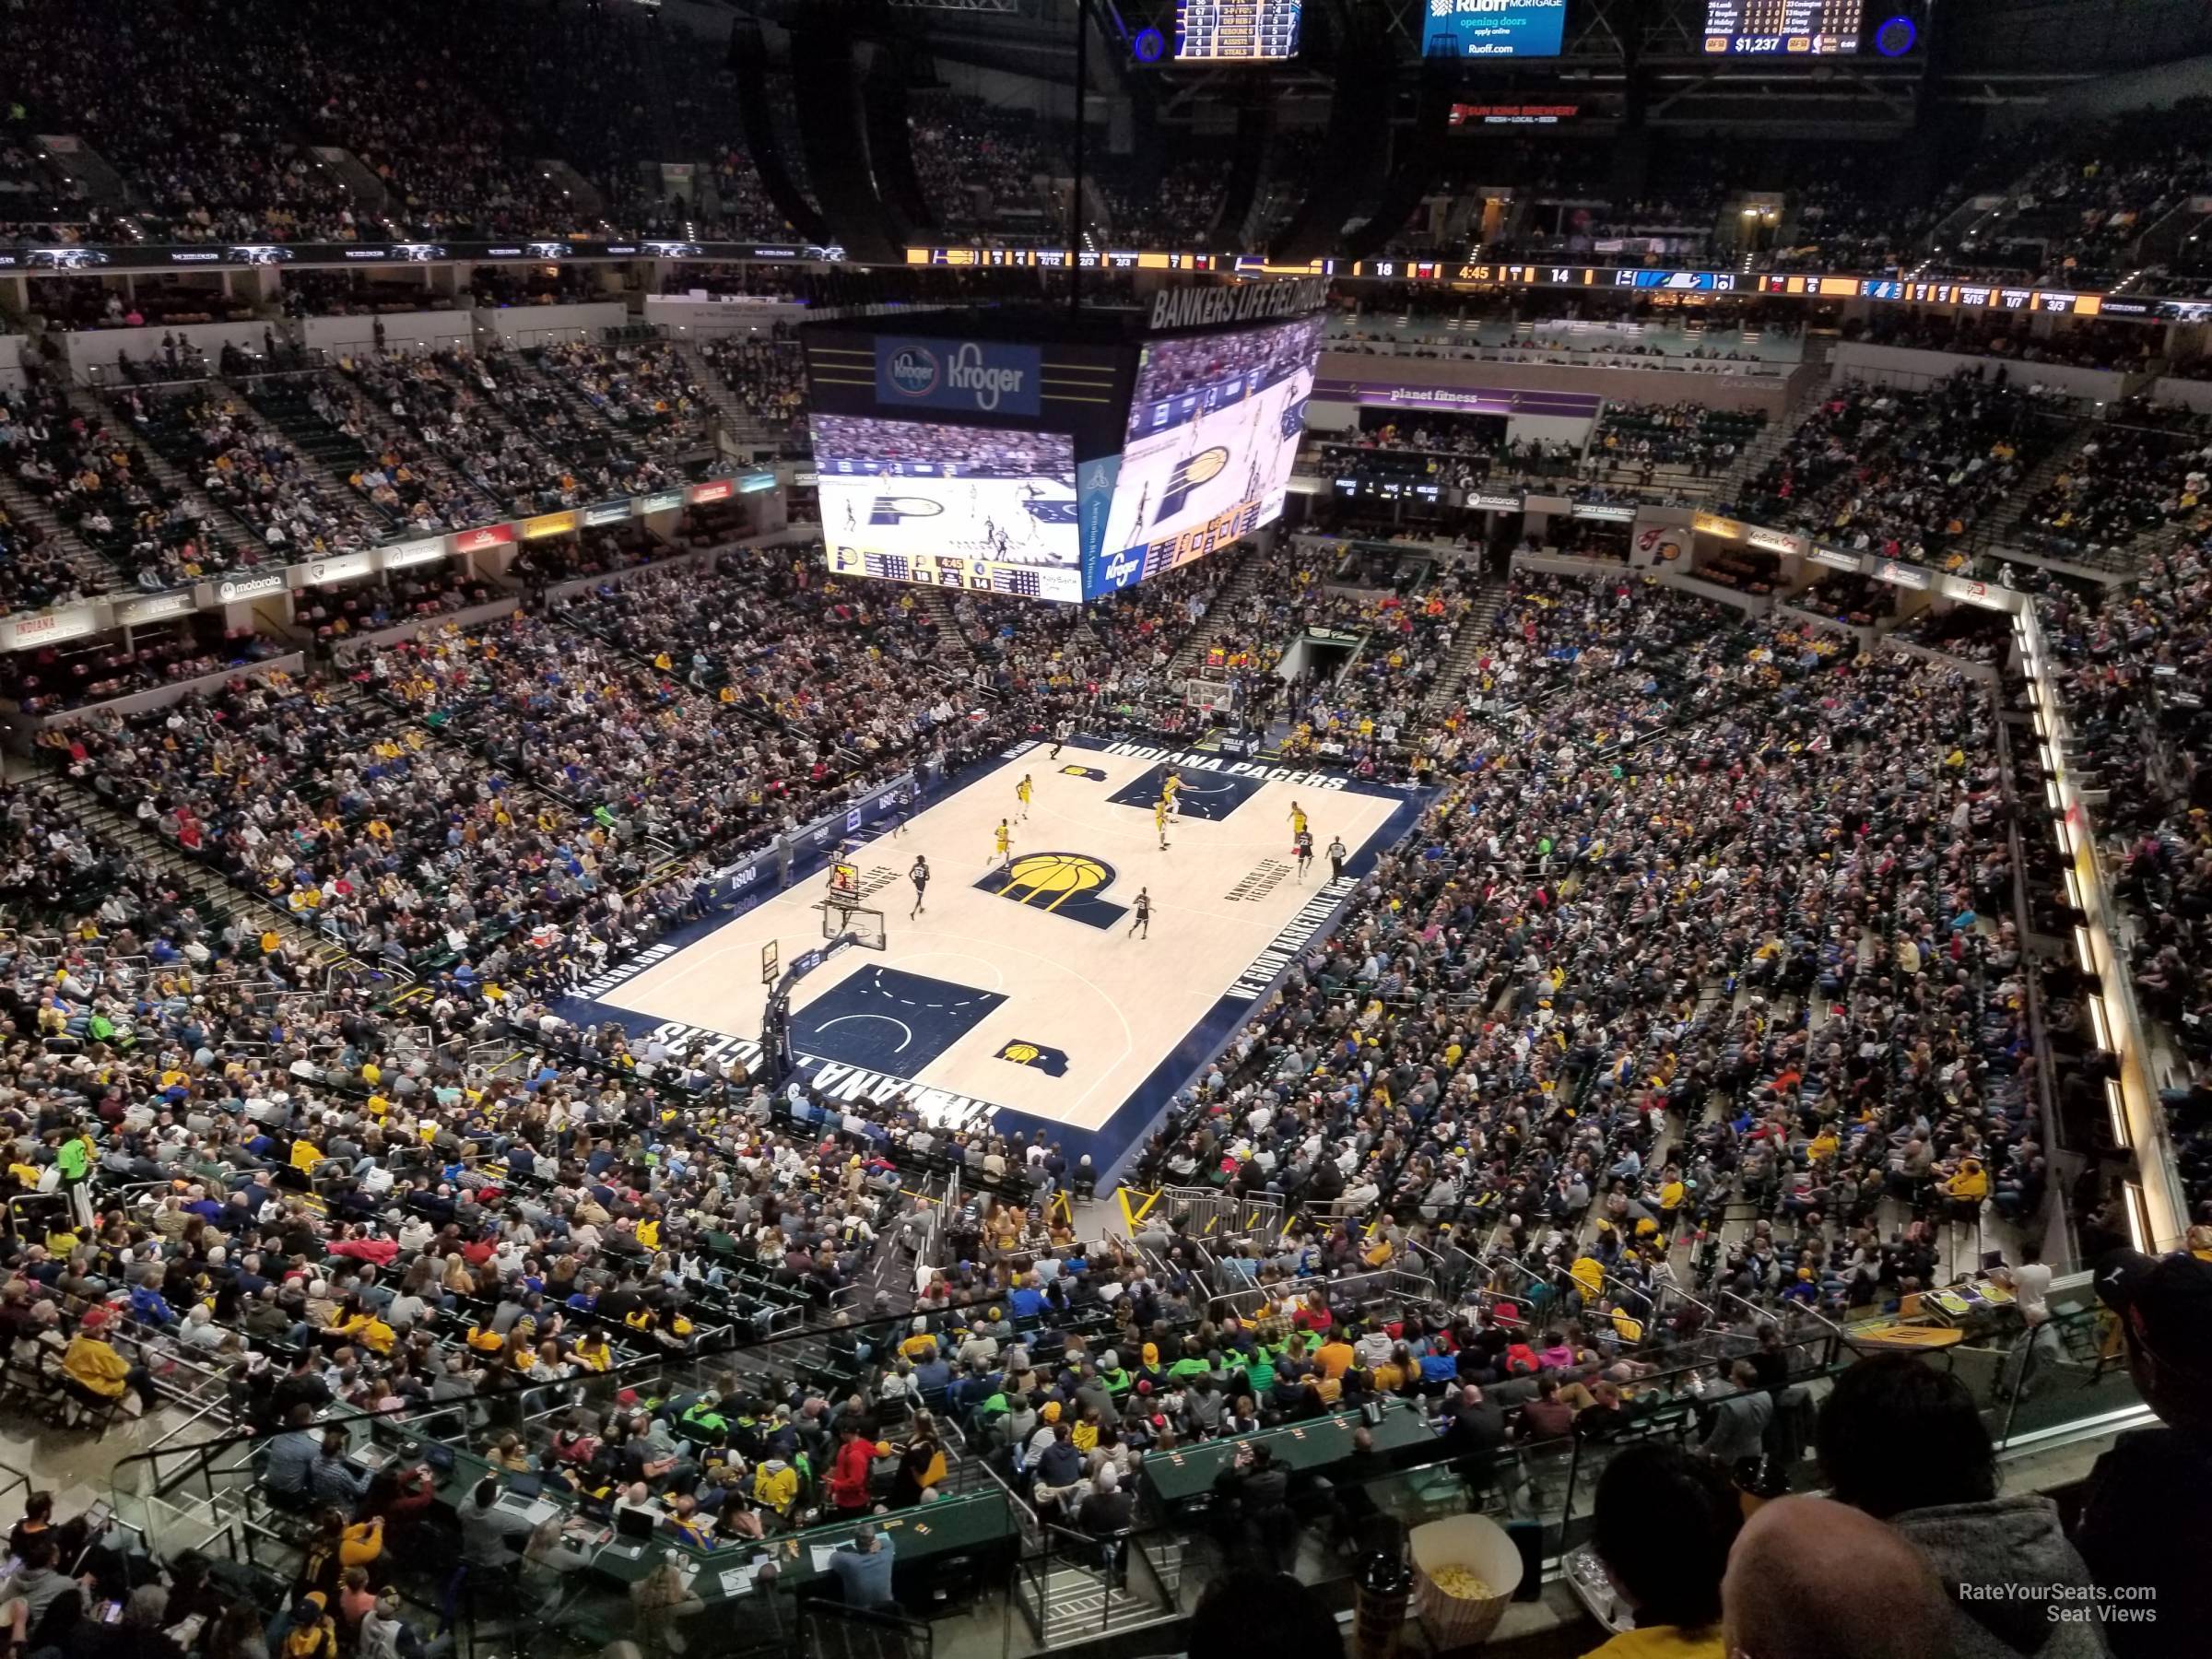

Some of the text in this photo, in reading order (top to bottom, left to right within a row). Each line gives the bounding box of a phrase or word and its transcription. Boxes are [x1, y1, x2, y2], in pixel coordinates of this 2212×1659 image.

[1461, 17, 1526, 28] opening doors
[1469, 43, 1513, 53] Ruoff.com
[1735, 39, 1779, 53] $1,237
[1171, 260, 1178, 268] 7
[1376, 264, 1393, 276] 18
[1459, 266, 1488, 279] 4:45
[1552, 269, 1569, 282] 14
[1772, 283, 1780, 291] 2
[1808, 284, 1816, 292] 6
[1917, 291, 1924, 300] 5
[1939, 292, 1946, 301] 5
[1963, 294, 1984, 305] 5/15
[1151, 277, 1334, 329] BANKERS LIFE FIELDHOUSE
[2006, 297, 2022, 308] 1/7
[2047, 300, 2065, 312] 3/3
[894, 354, 934, 388] Kroger
[947, 343, 1024, 410] Kroger
[1390, 388, 1477, 403] planet fitness
[1480, 496, 1519, 505] motorola
[1751, 531, 1780, 545] KeyBank
[942, 559, 963, 569] 4:45
[1105, 553, 1139, 587] Kroger
[916, 571, 929, 581] 18
[236, 575, 281, 594] motorola
[974, 579, 988, 588] 14
[16, 617, 55, 636] INDIANA
[1103, 742, 1224, 773] INDIANA
[1225, 761, 1348, 791] PACERS
[1224, 858, 1280, 902] BANKERS LIFE
[1244, 865, 1294, 902] FIELDHOUSE
[1271, 897, 1341, 952] BASKETBALL
[571, 943, 678, 1000] PACERS.COM
[1244, 948, 1293, 983] GROW
[1225, 980, 1266, 1001] WE
